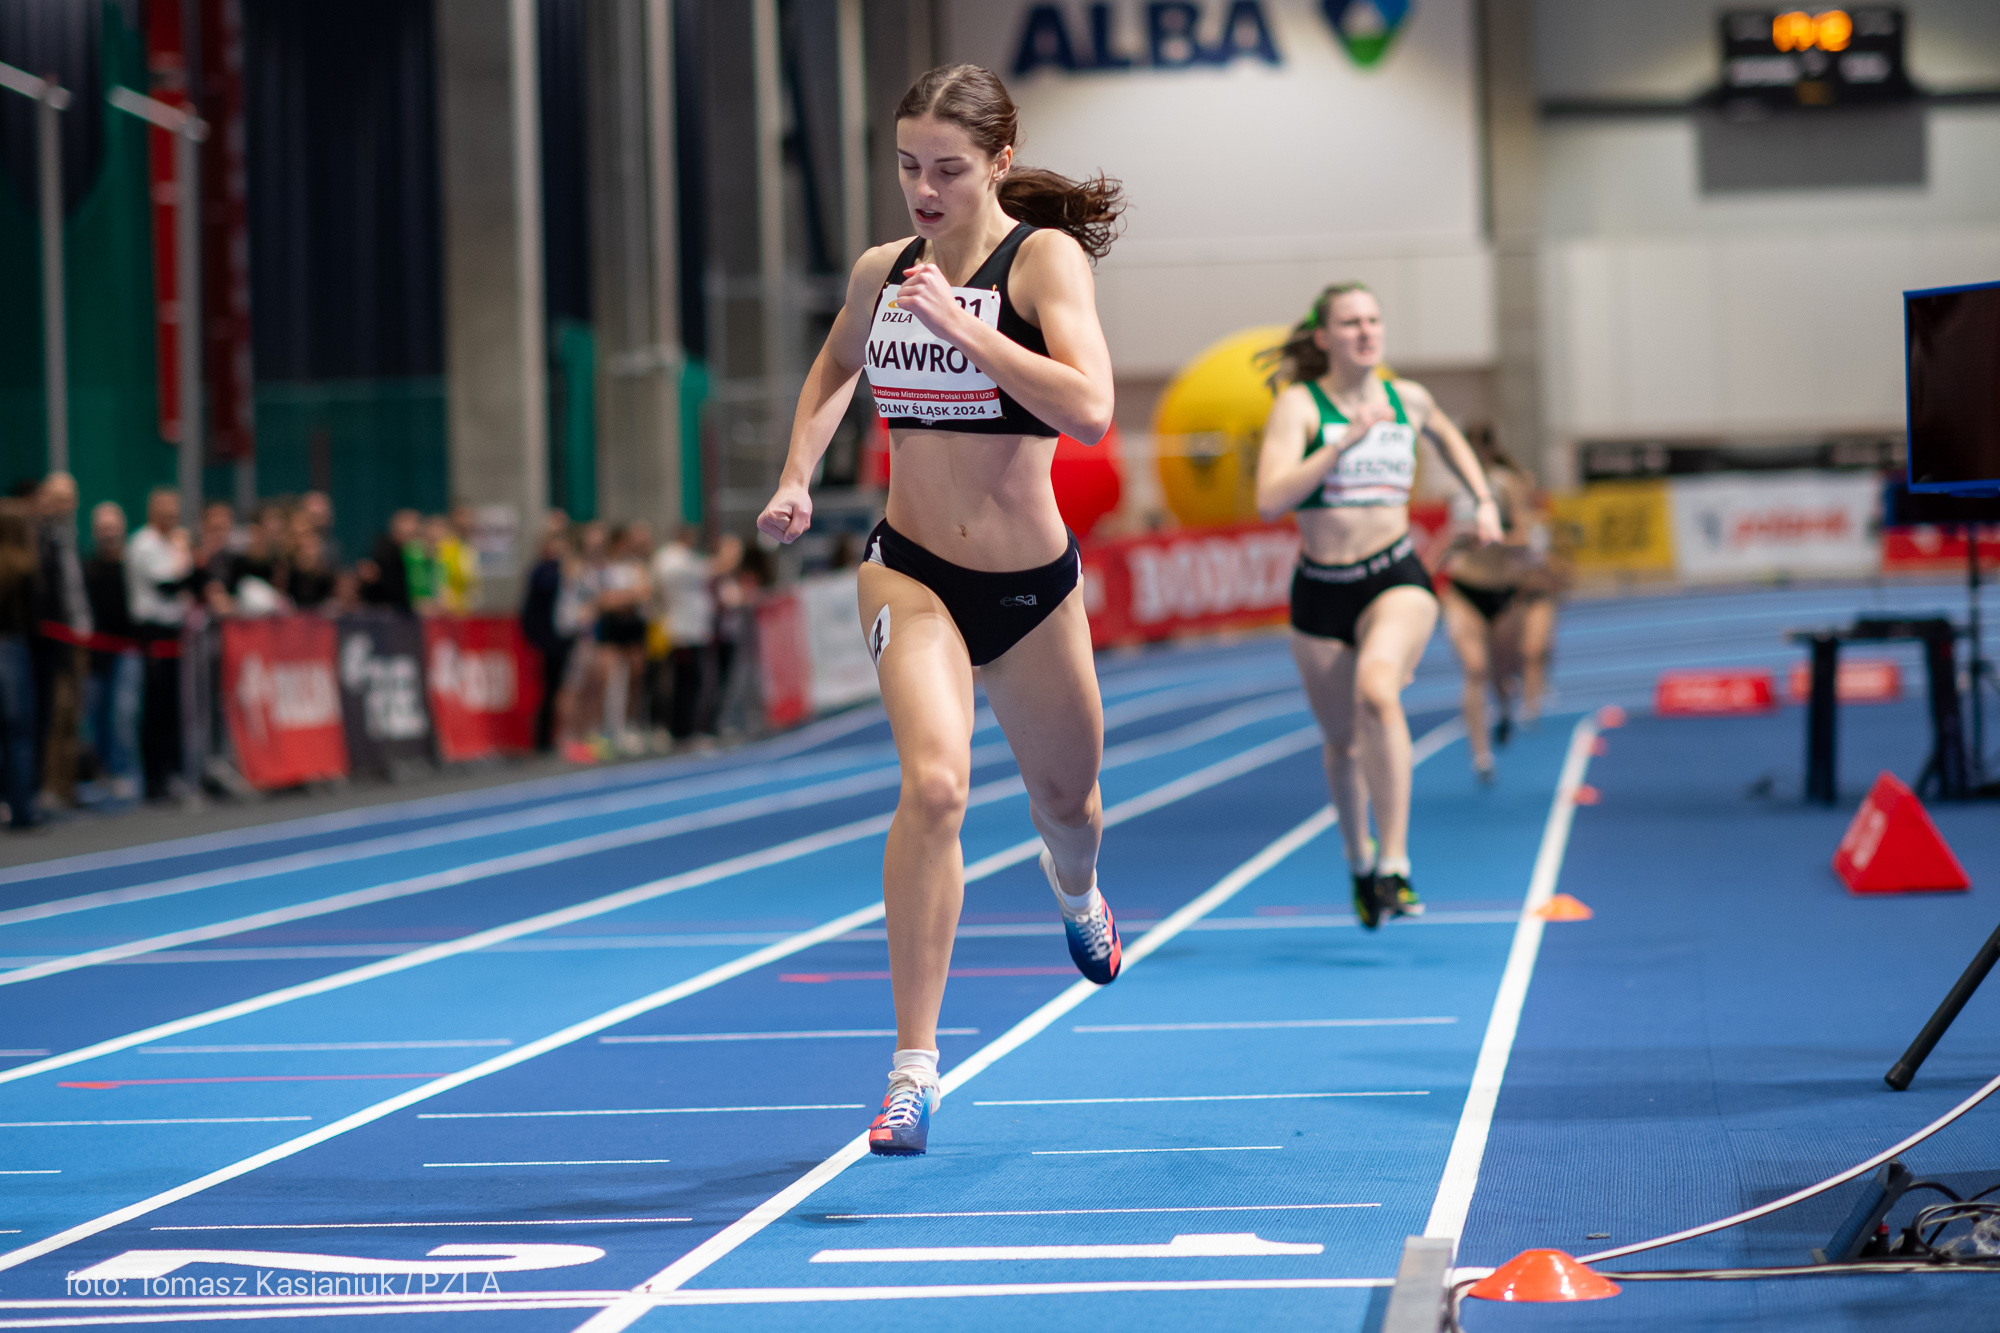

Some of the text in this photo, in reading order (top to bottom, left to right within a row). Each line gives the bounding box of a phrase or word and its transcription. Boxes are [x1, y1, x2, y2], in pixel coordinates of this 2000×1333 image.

[1010, 0, 1284, 76] ALBA
[881, 311, 913, 323] DZLA
[868, 340, 983, 374] NAWRO
[877, 389, 900, 397] Halowe
[901, 391, 940, 399] Mistrzostwa
[940, 392, 960, 400] Polski
[962, 392, 975, 400] U18
[980, 391, 995, 399] U20
[912, 402, 951, 418] ŚLĄSK
[953, 405, 986, 415] 2024
